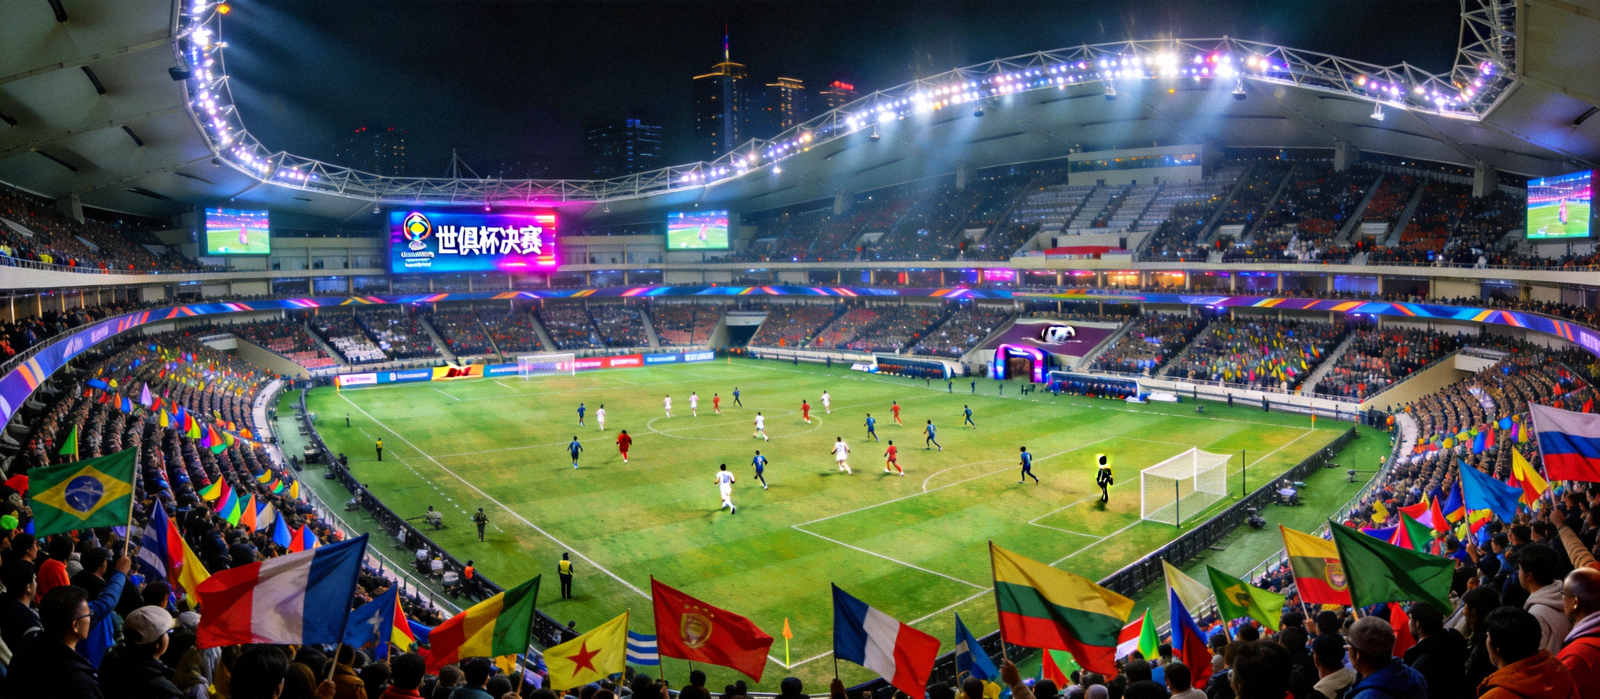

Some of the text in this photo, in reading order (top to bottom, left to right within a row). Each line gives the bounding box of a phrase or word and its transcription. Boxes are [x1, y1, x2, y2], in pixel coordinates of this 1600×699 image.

[435, 225, 543, 256] 世俱杯决赛
